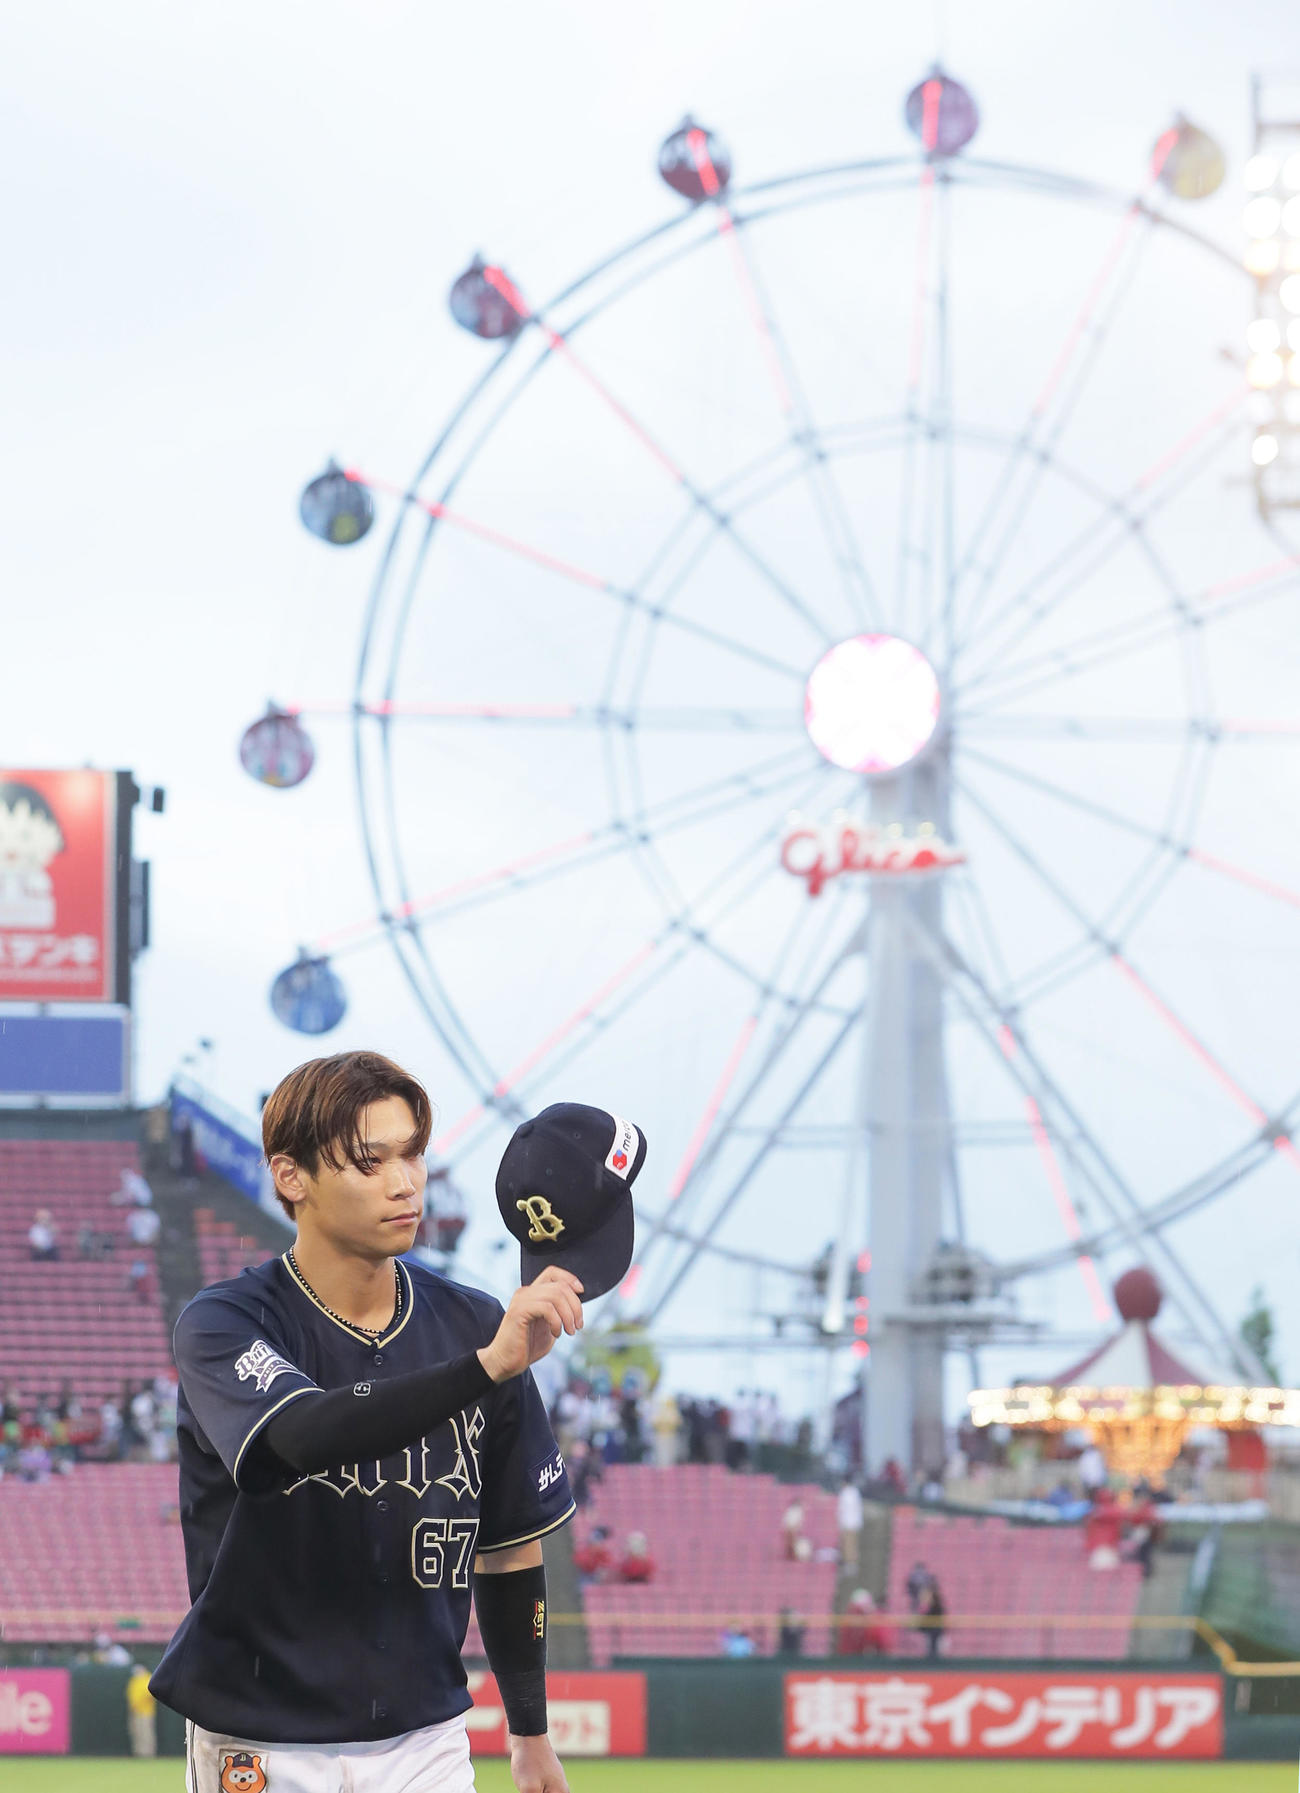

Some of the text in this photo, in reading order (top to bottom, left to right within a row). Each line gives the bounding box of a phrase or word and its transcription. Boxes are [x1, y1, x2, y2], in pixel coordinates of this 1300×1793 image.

[781, 829, 966, 898] Glico
[516, 1195, 566, 1242] B
[411, 1517, 480, 1589] 67
[537, 1600, 545, 1639] ZETT
[788, 1678, 1221, 1750] 東京インテリア
